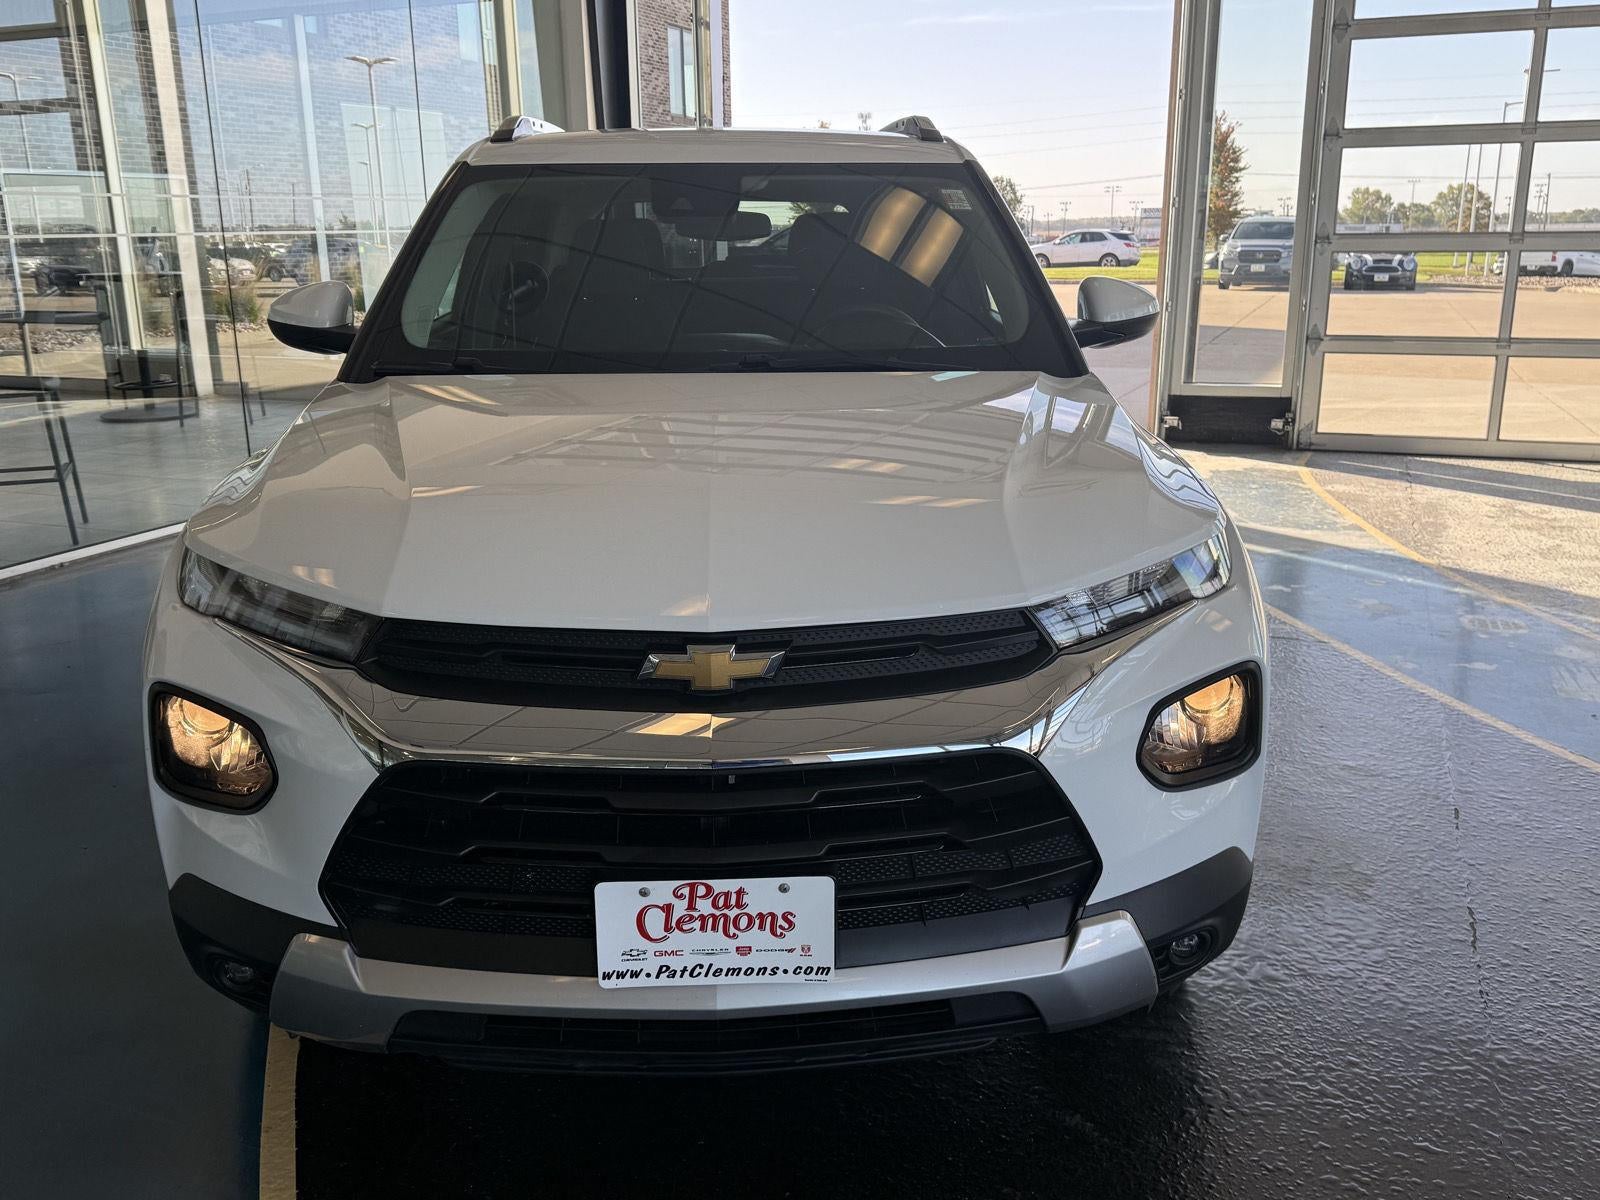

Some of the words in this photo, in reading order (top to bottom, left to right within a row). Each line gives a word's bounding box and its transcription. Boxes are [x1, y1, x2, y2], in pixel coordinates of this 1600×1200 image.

[672, 881, 748, 912] Pat
[635, 902, 797, 943] Clemons
[653, 949, 684, 957] GMC
